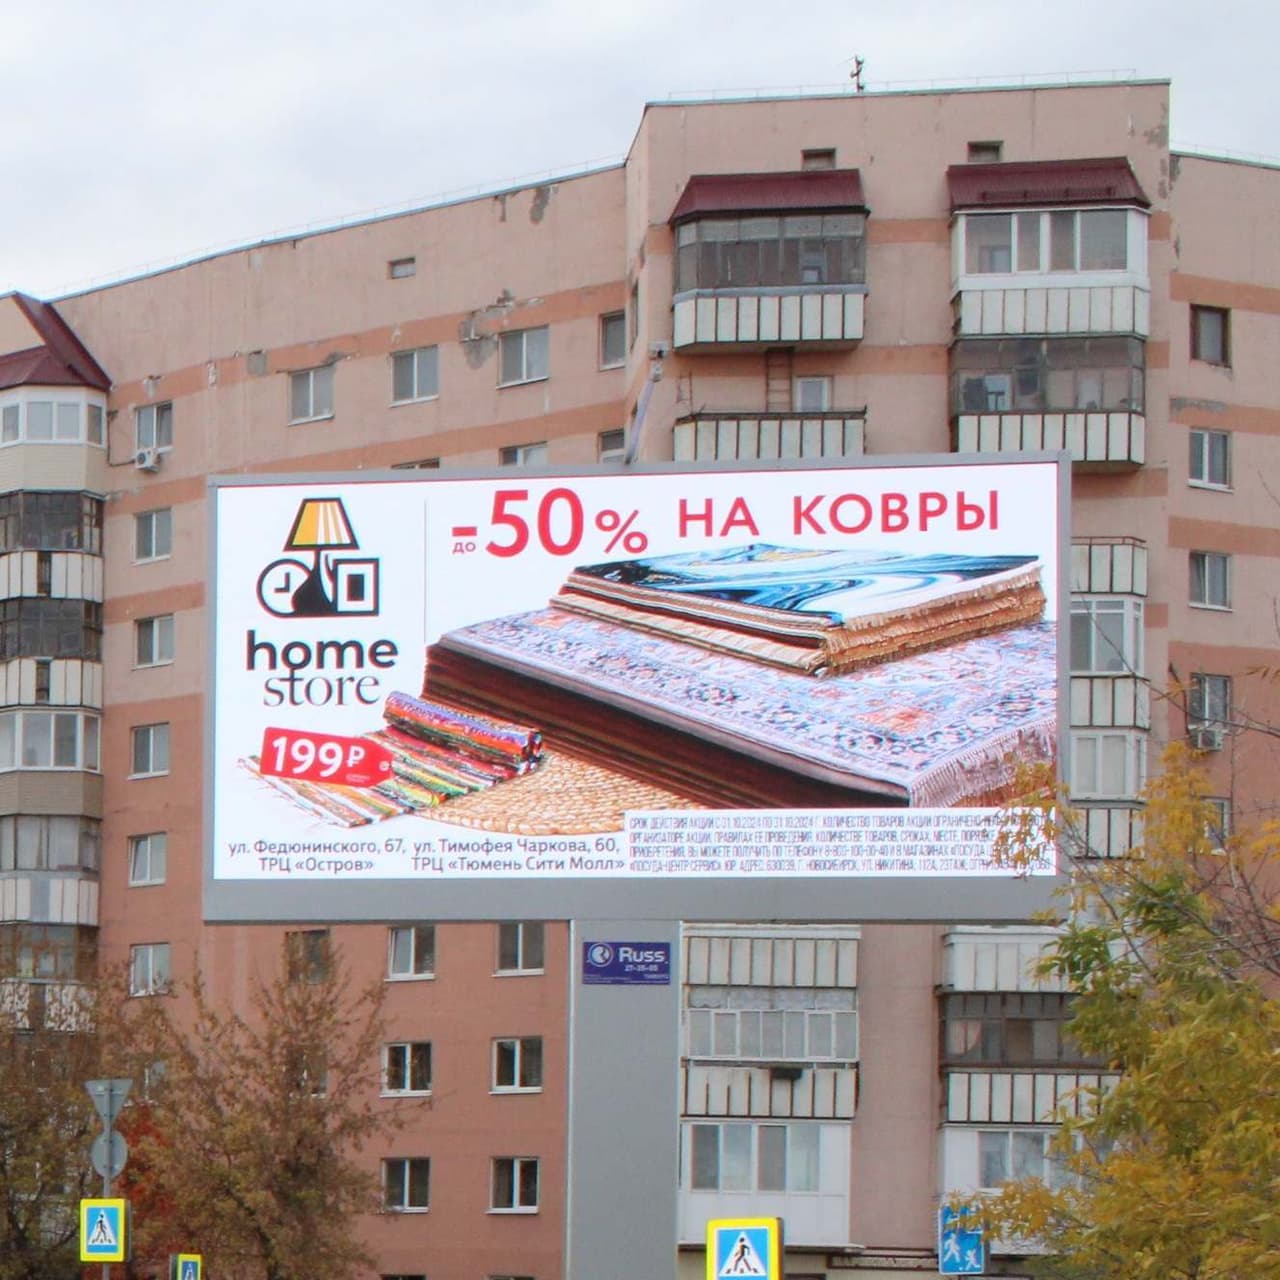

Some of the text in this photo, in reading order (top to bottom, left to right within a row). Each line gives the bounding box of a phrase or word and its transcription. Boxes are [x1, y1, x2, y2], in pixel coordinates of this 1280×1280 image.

[679, 498, 760, 537] НА
[793, 490, 999, 535] КОВРЫ
[246, 629, 399, 671] home
[263, 669, 381, 707] store
[228, 839, 406, 856] ул. Федюнинского, 67,
[413, 838, 621, 855] ул. Тимофея Чаркова, 60,
[259, 857, 374, 874] ТРЦ «Остров»
[411, 856, 625, 874] ТРЦ «Тюмень Сити Молл»
[618, 946, 665, 963] Russ
